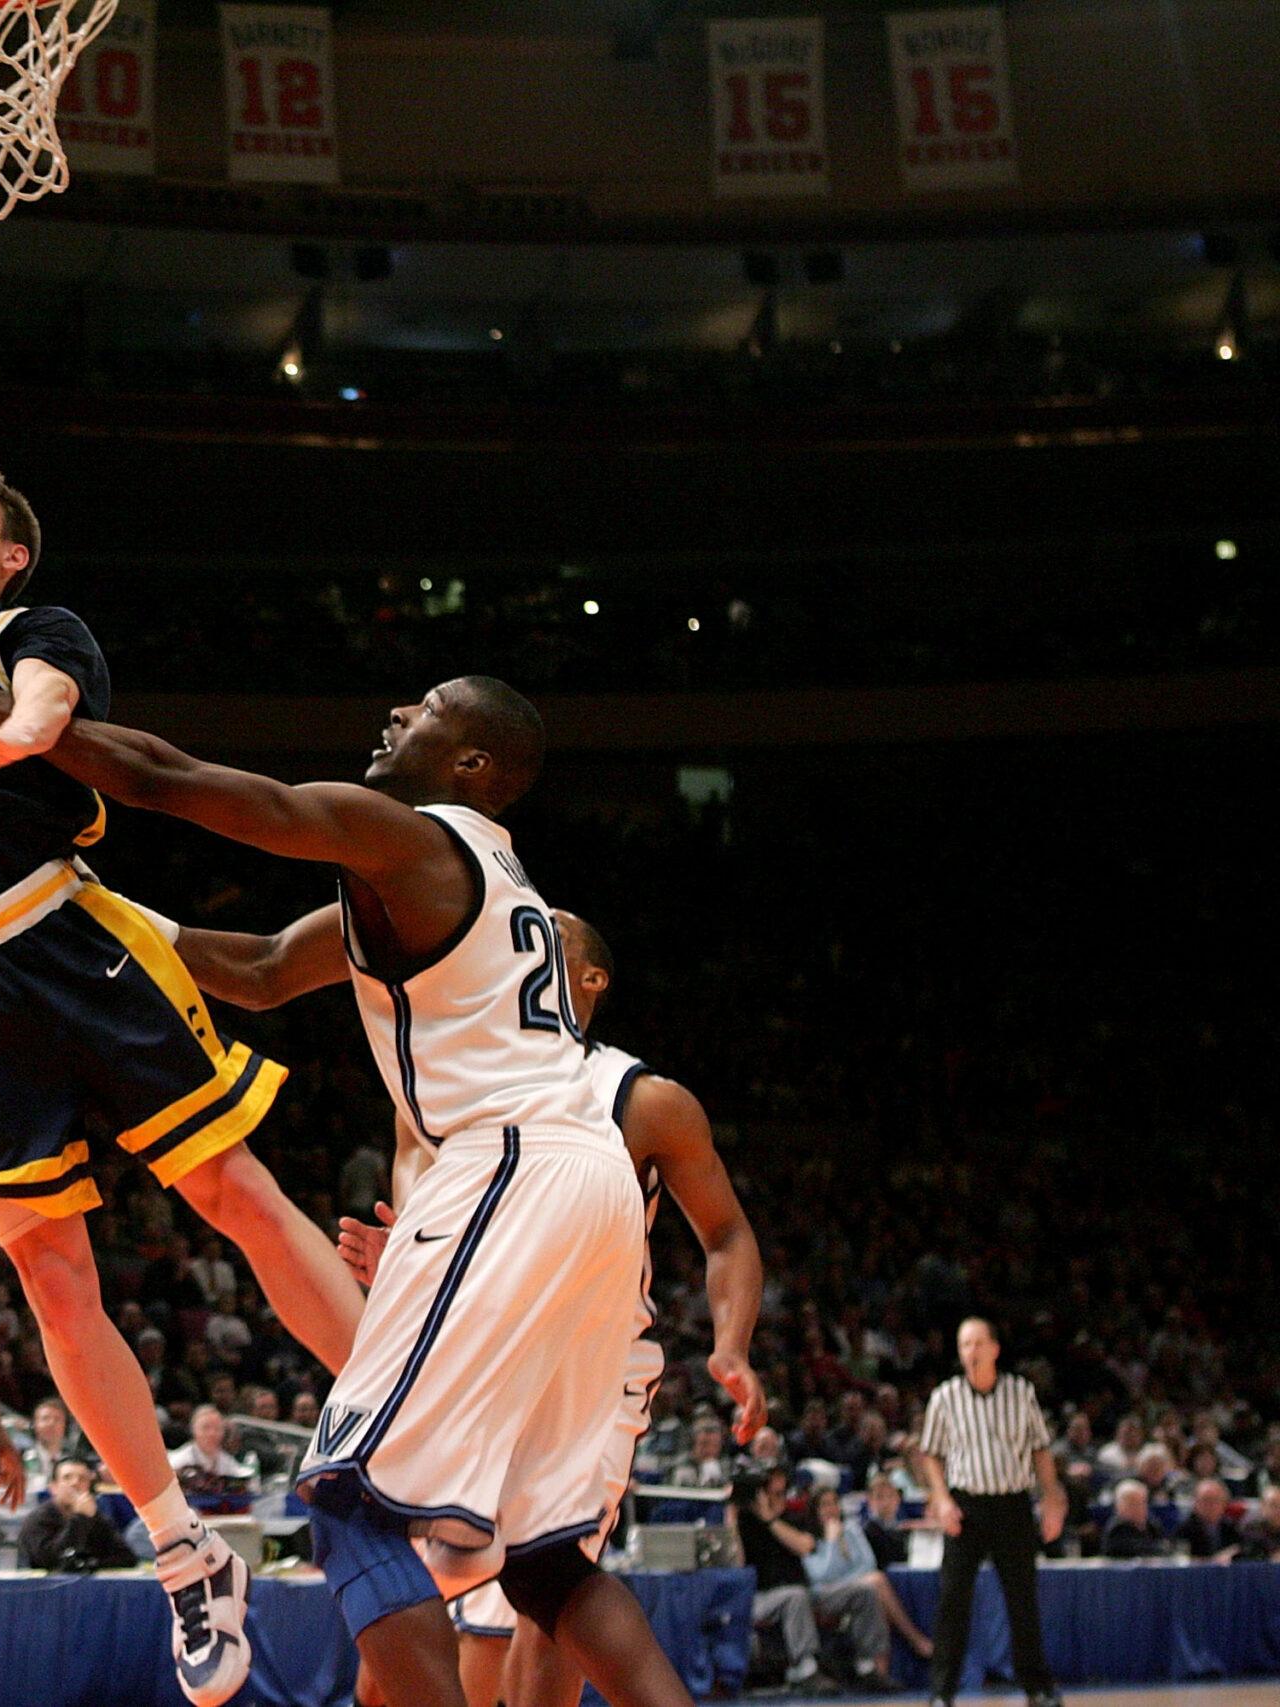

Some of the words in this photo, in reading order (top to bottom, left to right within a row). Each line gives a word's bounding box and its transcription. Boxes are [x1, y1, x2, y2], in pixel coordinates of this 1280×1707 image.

[238, 58, 322, 127] 12
[726, 72, 811, 142] 15
[911, 65, 1000, 135] 15
